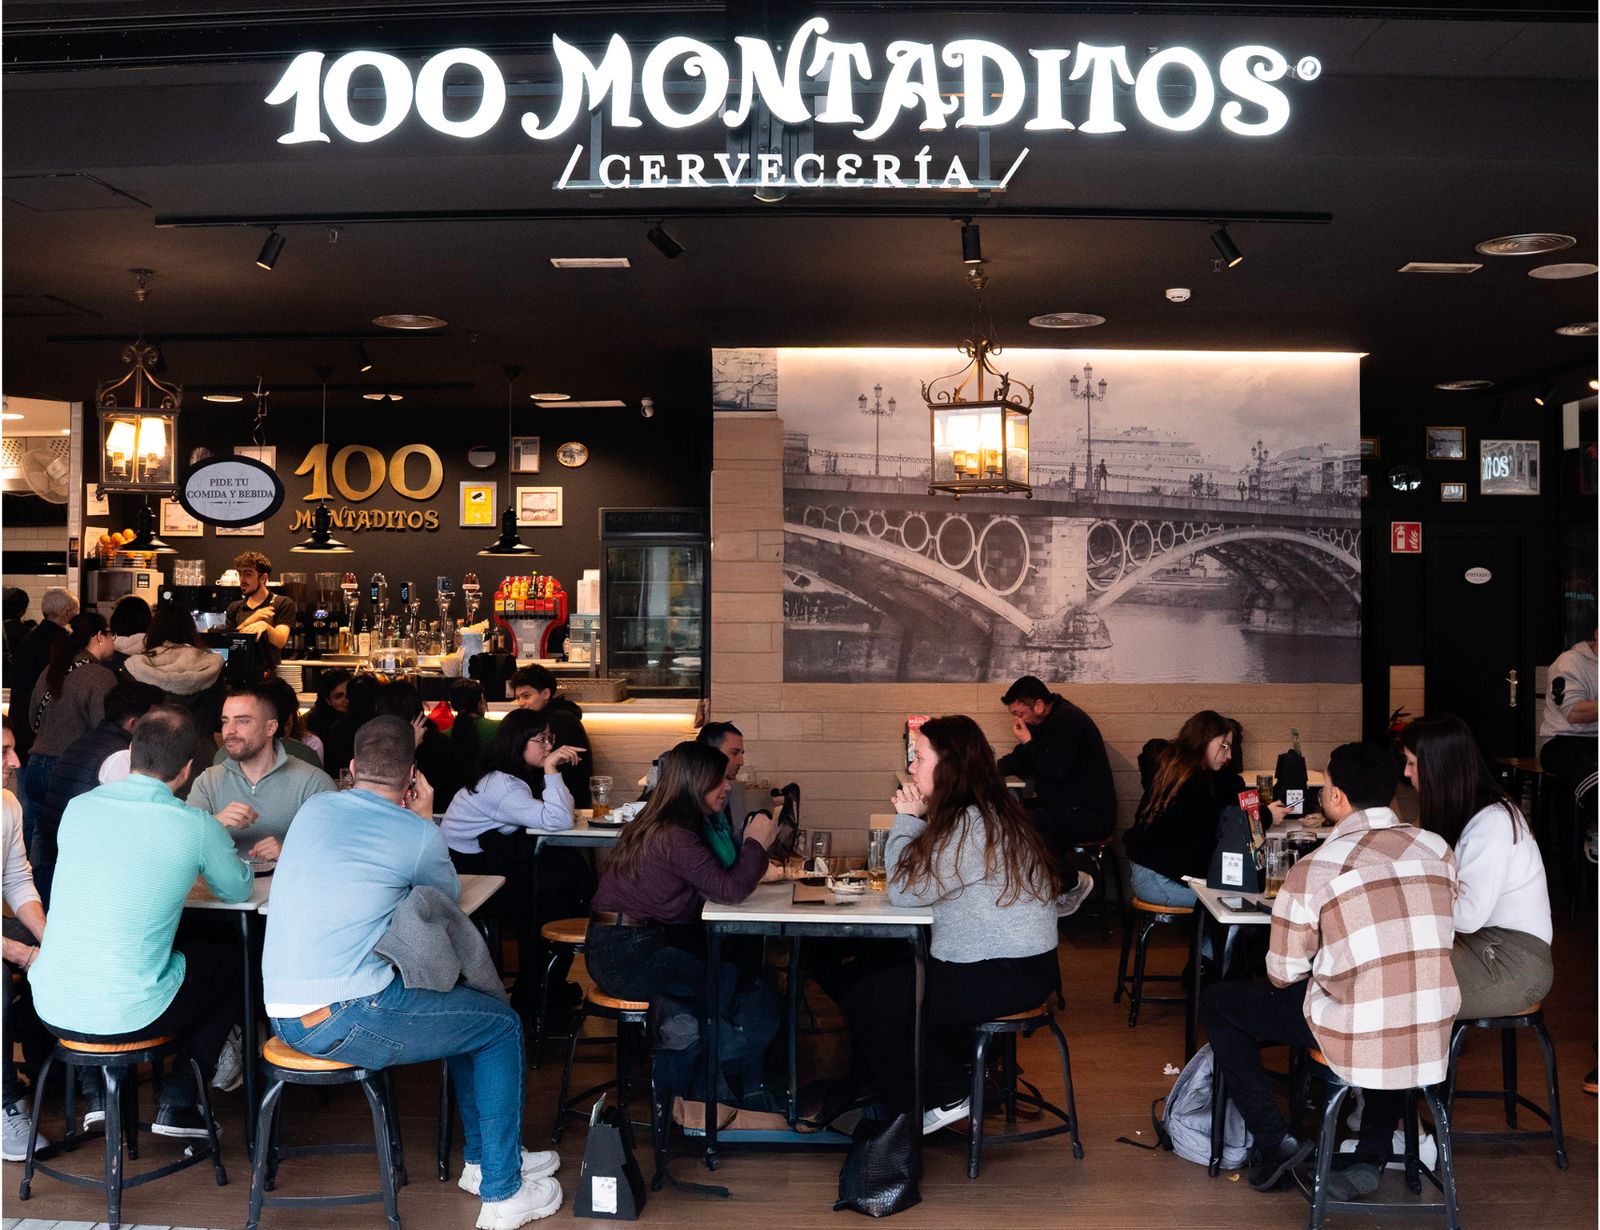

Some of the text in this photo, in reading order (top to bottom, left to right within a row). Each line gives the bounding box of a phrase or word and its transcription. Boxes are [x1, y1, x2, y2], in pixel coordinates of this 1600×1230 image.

[264, 48, 507, 144] 100
[598, 145, 974, 189] CERVECERÍA
[209, 478, 249, 487] PIDE TU
[294, 443, 443, 501] 100
[186, 490, 274, 499] COMIDA Y BEBIDA
[289, 505, 439, 531] MNTADITOS
